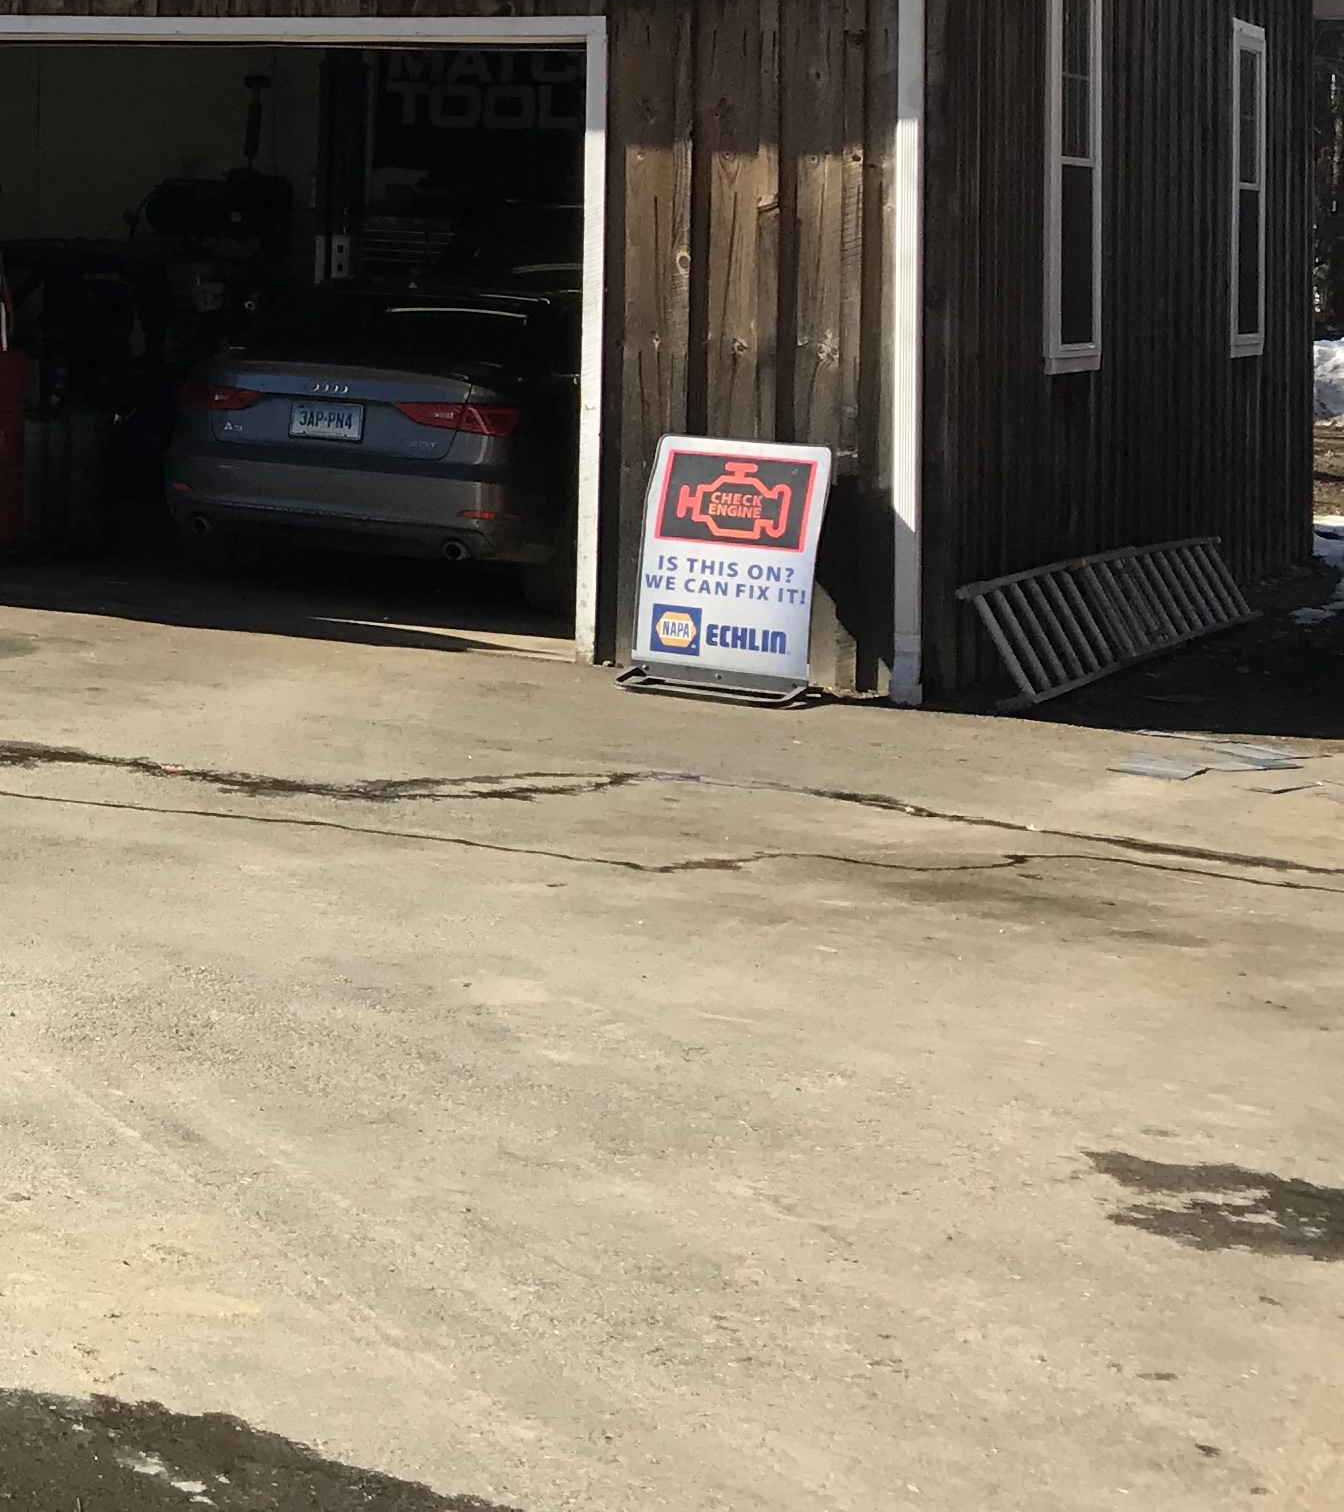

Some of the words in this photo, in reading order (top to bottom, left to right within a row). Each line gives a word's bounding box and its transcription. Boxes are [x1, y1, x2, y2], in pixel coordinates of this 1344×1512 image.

[710, 491, 762, 507] CHECK
[708, 504, 762, 519] ENGINE
[658, 555, 678, 572] IS
[686, 557, 738, 578] THIS
[747, 564, 795, 584] ON?
[645, 573, 676, 591] WE
[684, 578, 729, 597] CAN
[735, 583, 770, 602] FIX
[778, 588, 807, 605] IT!
[662, 620, 690, 639] NAPA
[705, 623, 787, 655] ECHLIN
